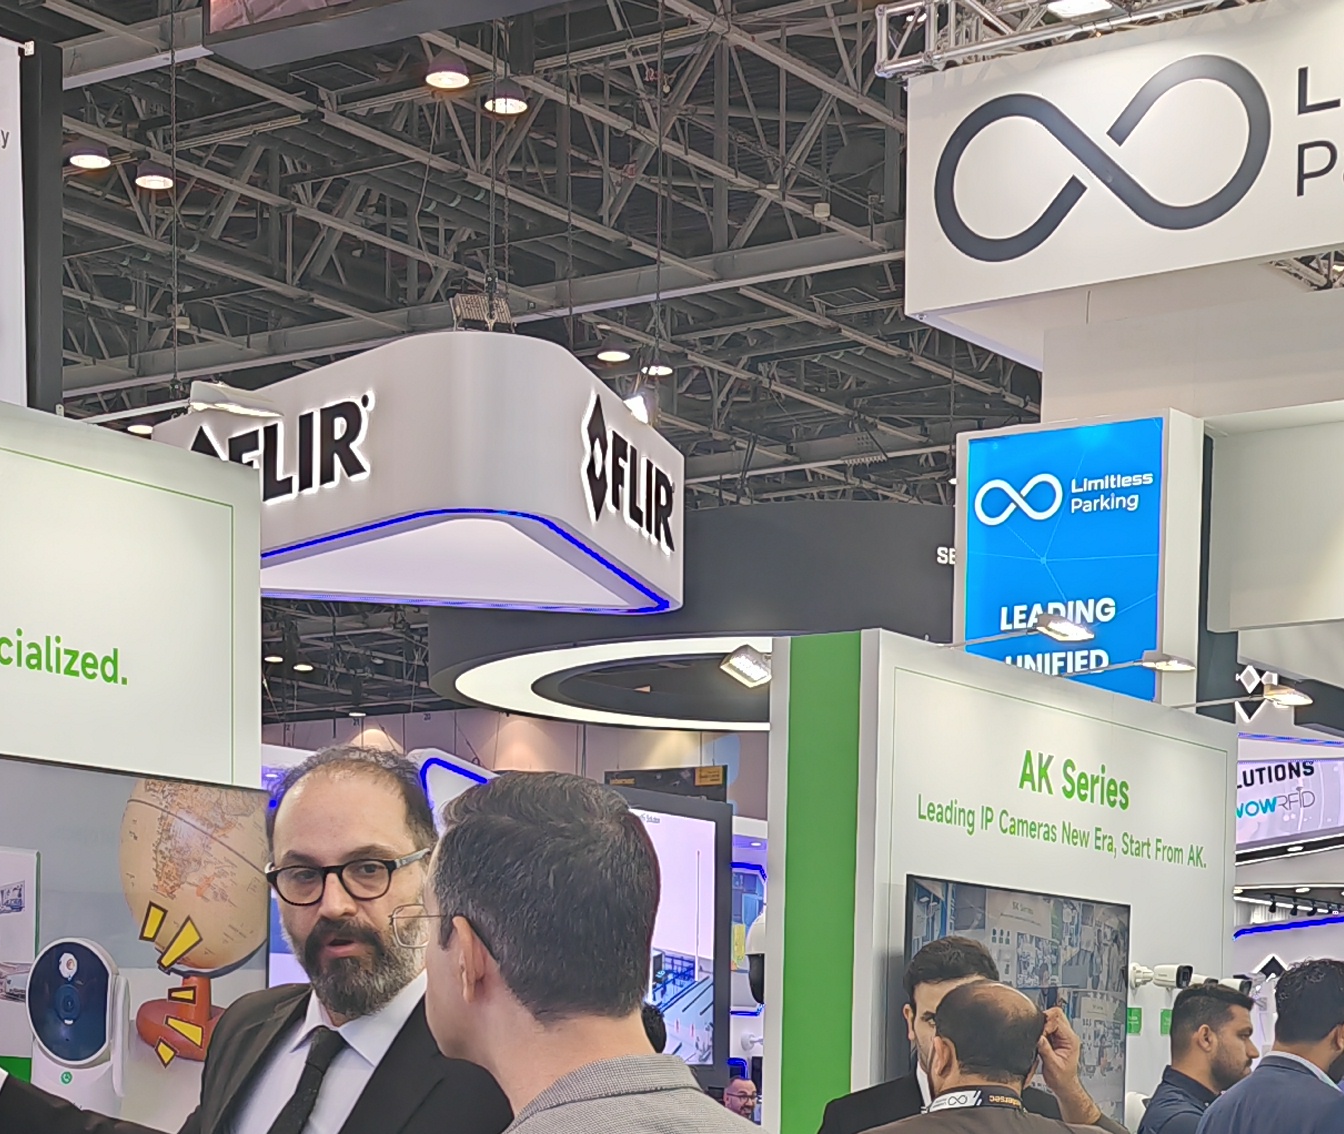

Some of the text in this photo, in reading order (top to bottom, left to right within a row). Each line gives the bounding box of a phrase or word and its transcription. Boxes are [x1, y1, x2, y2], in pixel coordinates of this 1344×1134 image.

[609, 437, 674, 552] FLIR
[1071, 473, 1154, 494] Limitless
[1071, 493, 1139, 514] Parking
[1018, 749, 1130, 811] AK Series
[918, 794, 1207, 869] Leading IP Cameras New Era, Start From AK.
